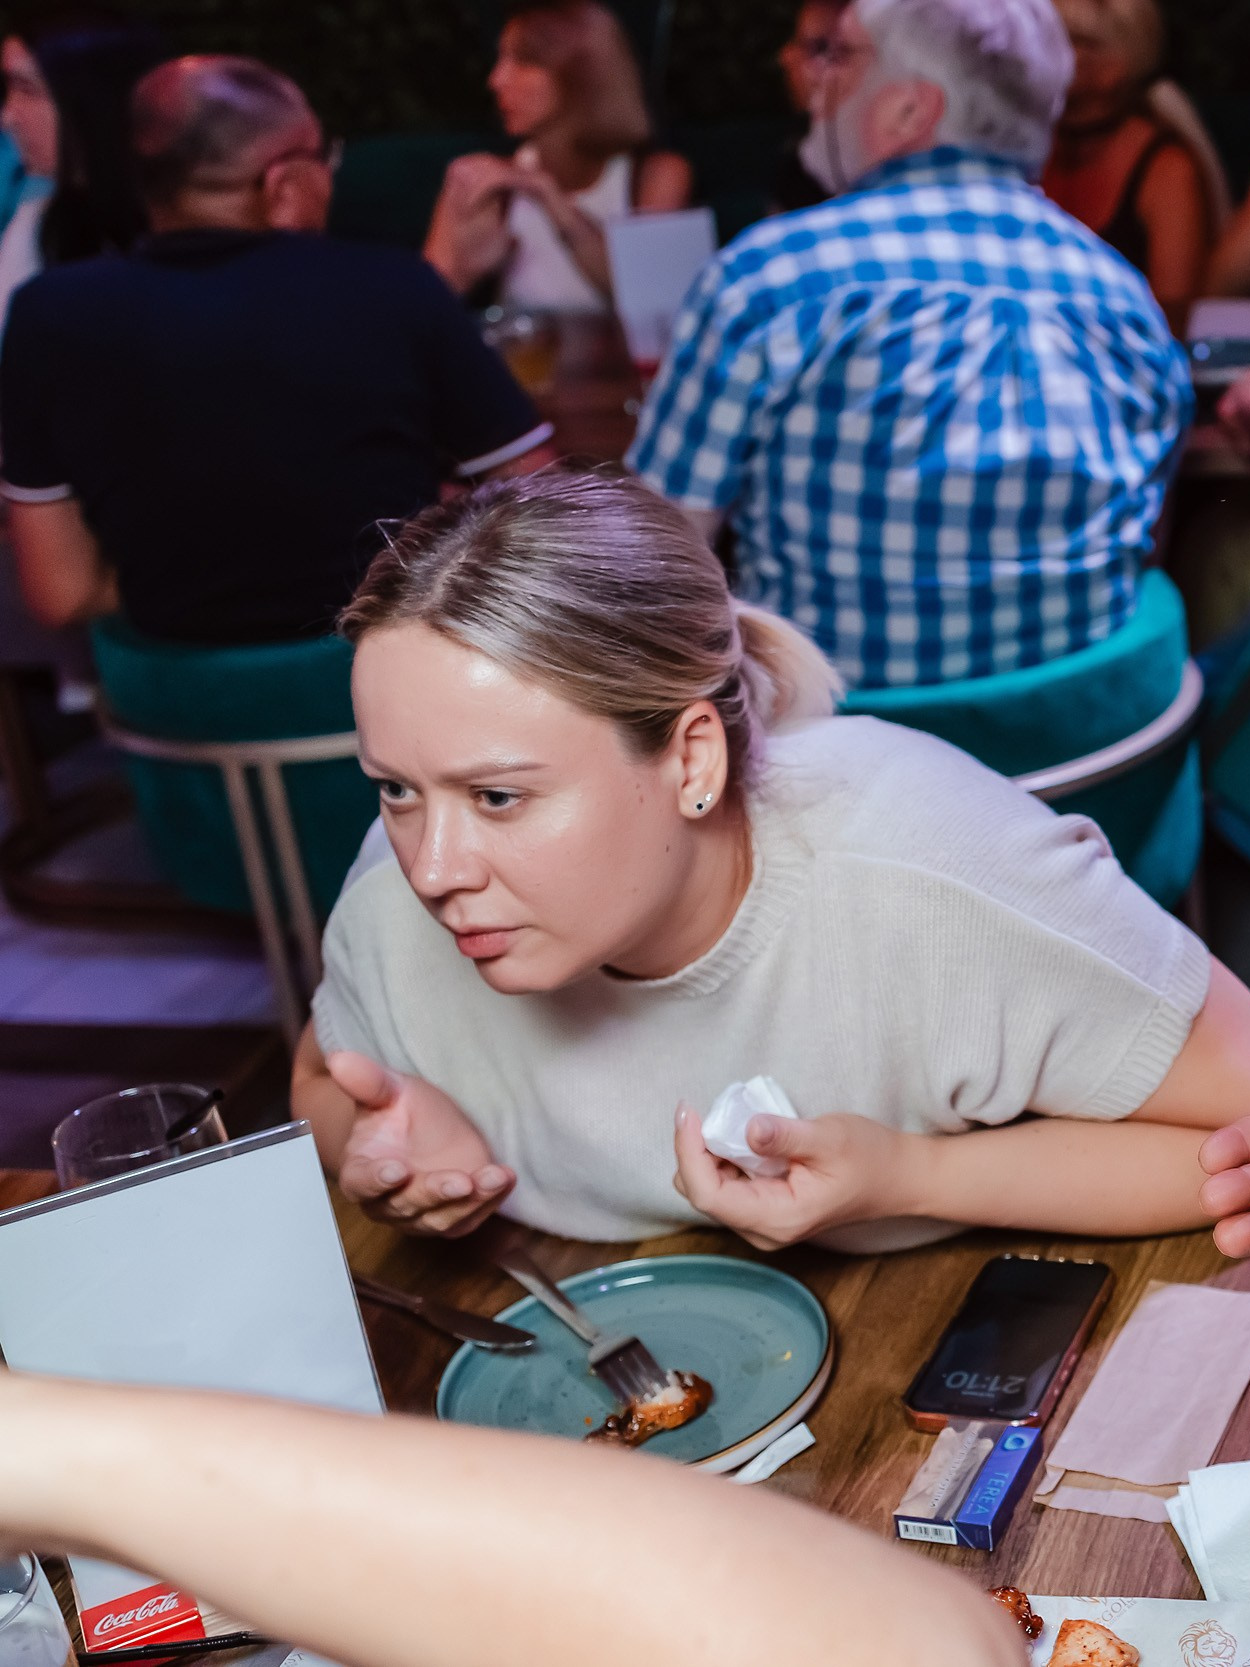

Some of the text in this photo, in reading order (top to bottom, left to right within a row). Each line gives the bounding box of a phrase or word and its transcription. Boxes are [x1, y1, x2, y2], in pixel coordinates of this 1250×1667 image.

[945, 1371, 1026, 1394] 21:10
[972, 1471, 1009, 1515] TEREA
[93, 1591, 179, 1636] Coca-Cola
